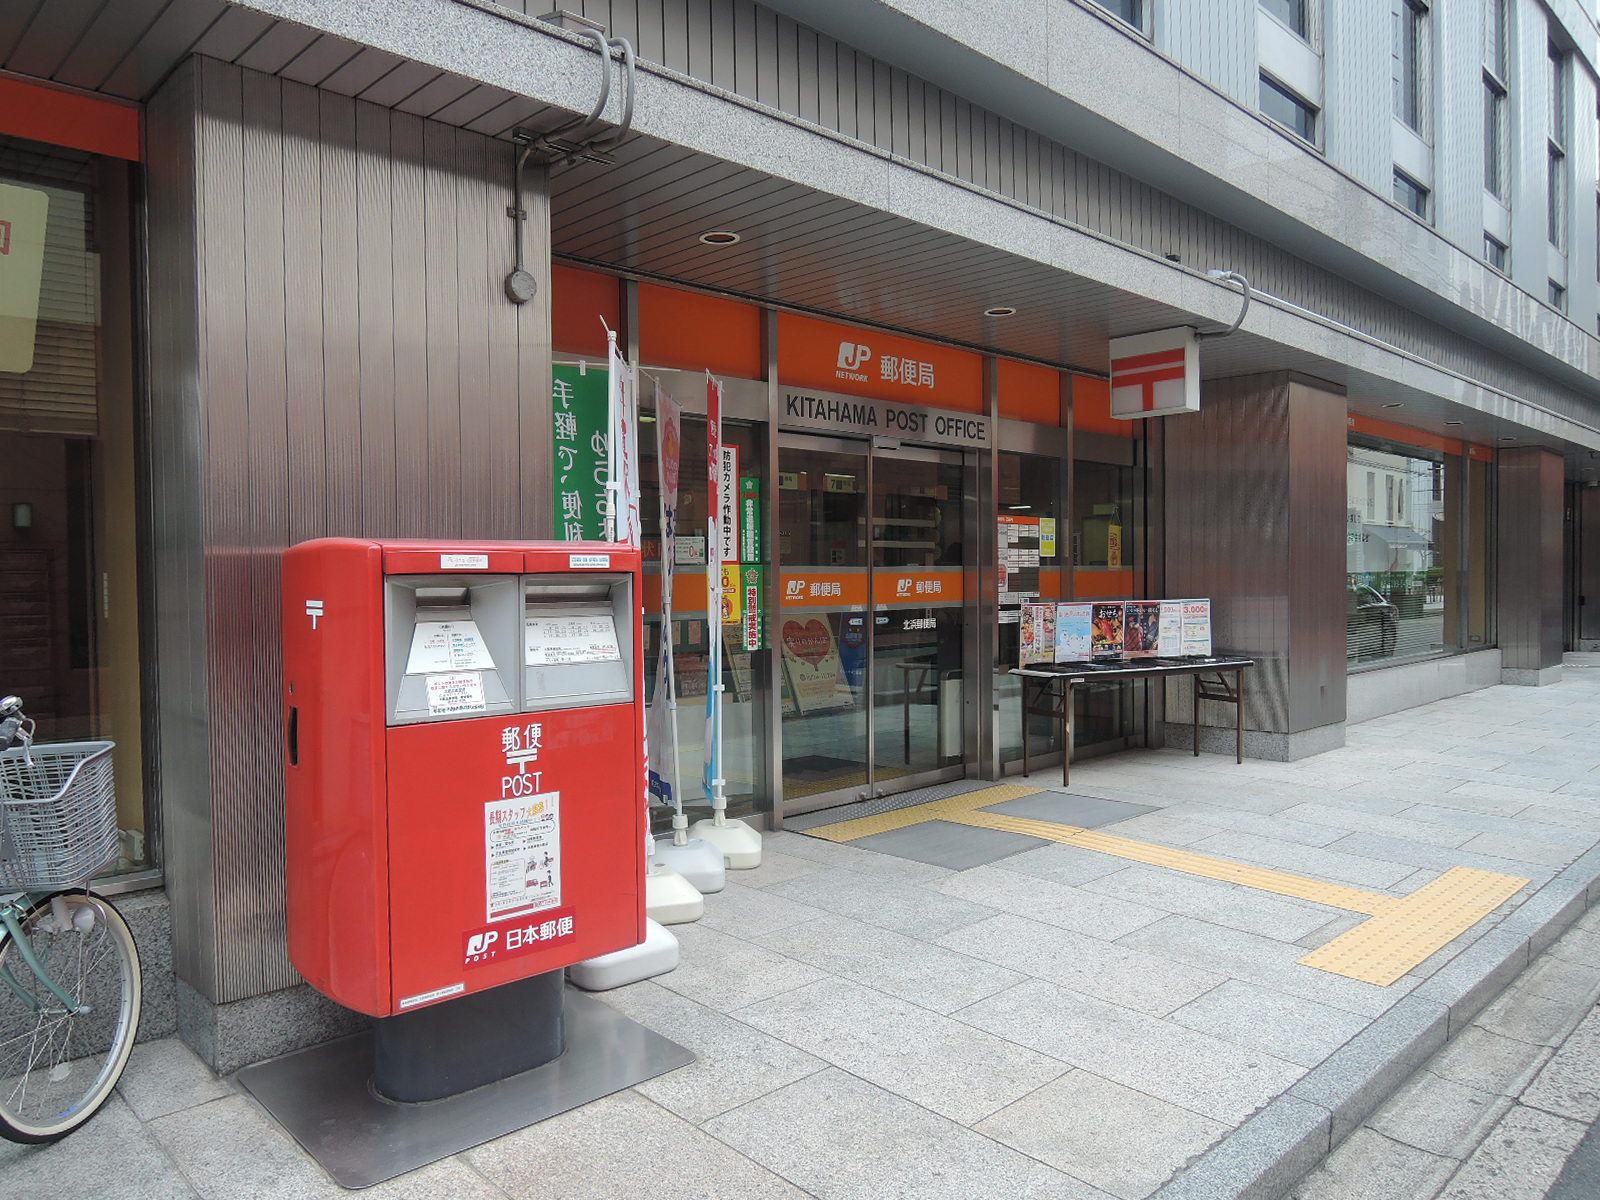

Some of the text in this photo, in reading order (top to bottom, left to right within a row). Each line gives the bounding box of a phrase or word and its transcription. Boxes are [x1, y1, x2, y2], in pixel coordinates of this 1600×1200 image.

[835, 370, 869, 383] NETWORK
[880, 355, 935, 389] 郵便局
[786, 394, 986, 441] KITAHAMA POST OFFICE
[722, 450, 732, 557] 防犯カメラ作動中です
[809, 582, 841, 597] 郵便局
[915, 580, 942, 594] 郵便局
[1098, 608, 1119, 619] おせち
[501, 723, 543, 752] 郵便
[501, 772, 543, 798] POST
[506, 915, 574, 950] 日本郵便
[464, 951, 497, 964] POST
